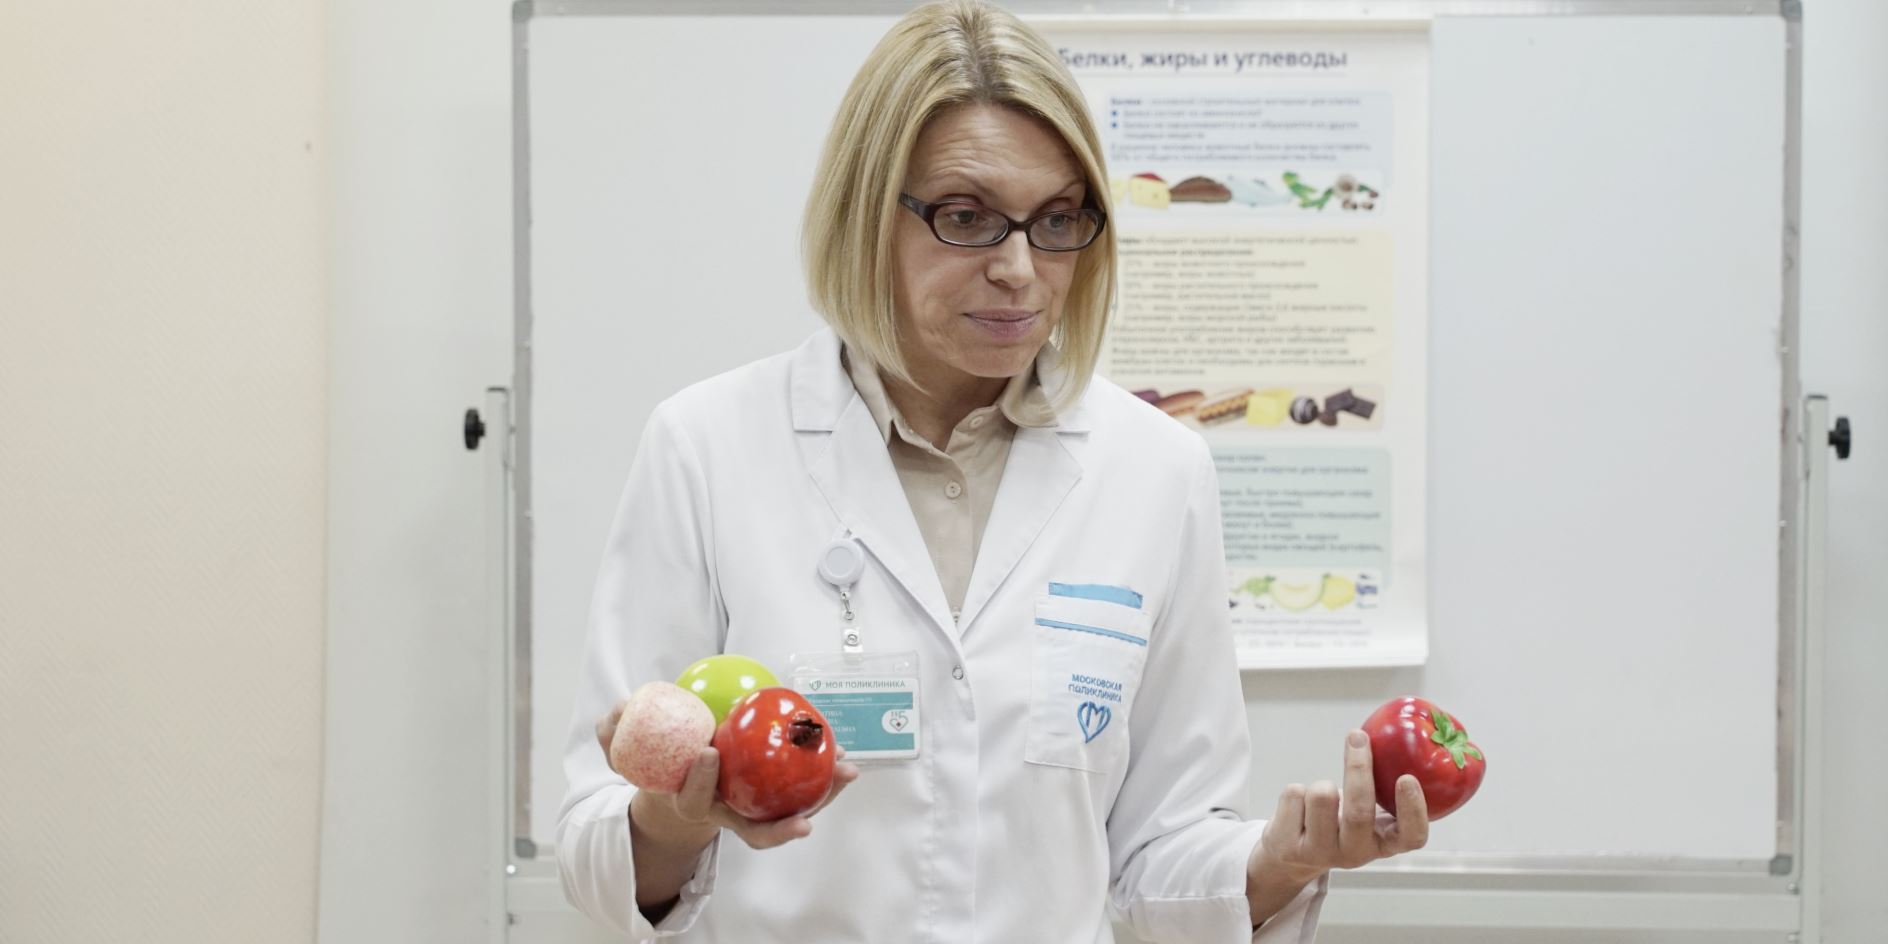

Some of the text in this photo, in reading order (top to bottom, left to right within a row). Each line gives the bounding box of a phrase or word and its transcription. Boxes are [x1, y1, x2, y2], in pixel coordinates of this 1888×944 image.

[1058, 48, 1348, 72] Белки, жиры и углеводы
[825, 680, 906, 689] МОЯ ПОЛИКЛИНИКА
[1071, 673, 1122, 692] МОСКОВСКАЯ
